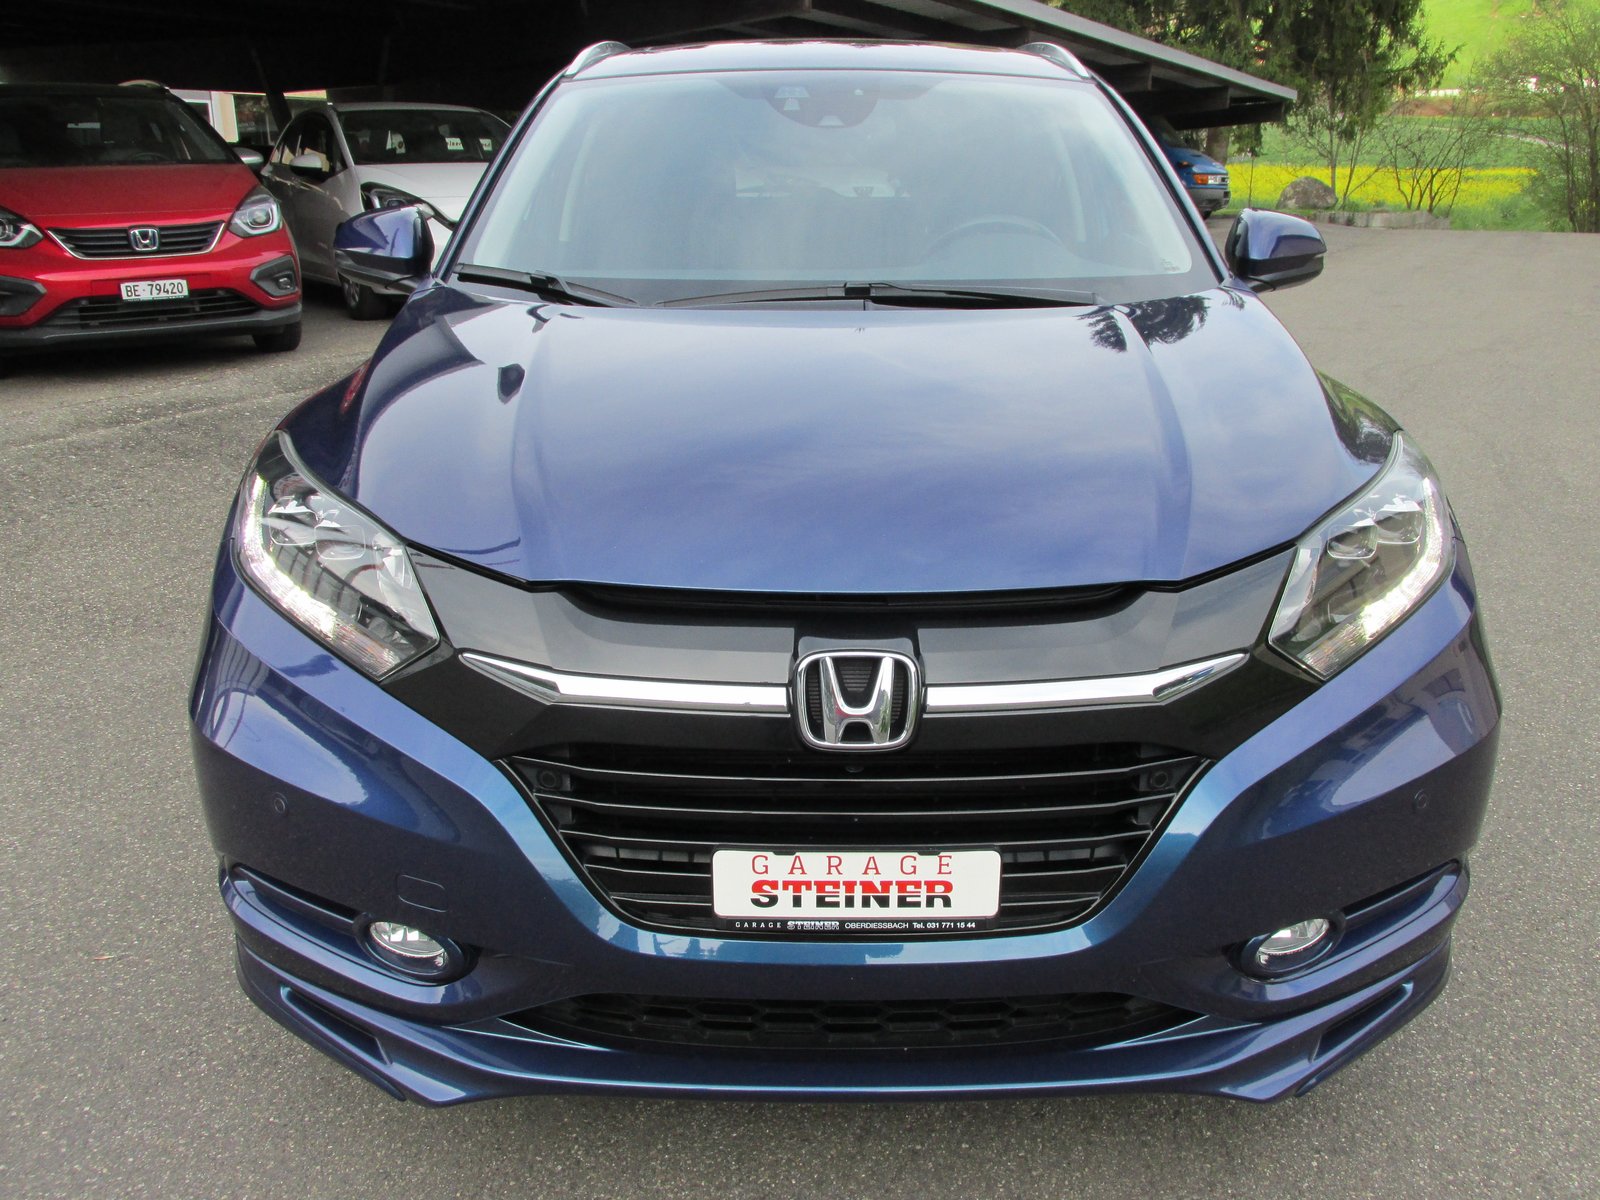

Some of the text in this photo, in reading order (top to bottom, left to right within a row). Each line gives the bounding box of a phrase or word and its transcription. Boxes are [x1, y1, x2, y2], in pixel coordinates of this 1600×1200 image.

[751, 854, 953, 875] GARAGE
[750, 879, 954, 908] STEINER
[735, 920, 976, 930] GARAGE STEINER OBERDIESSBACH Tel. 031 771 15 44
